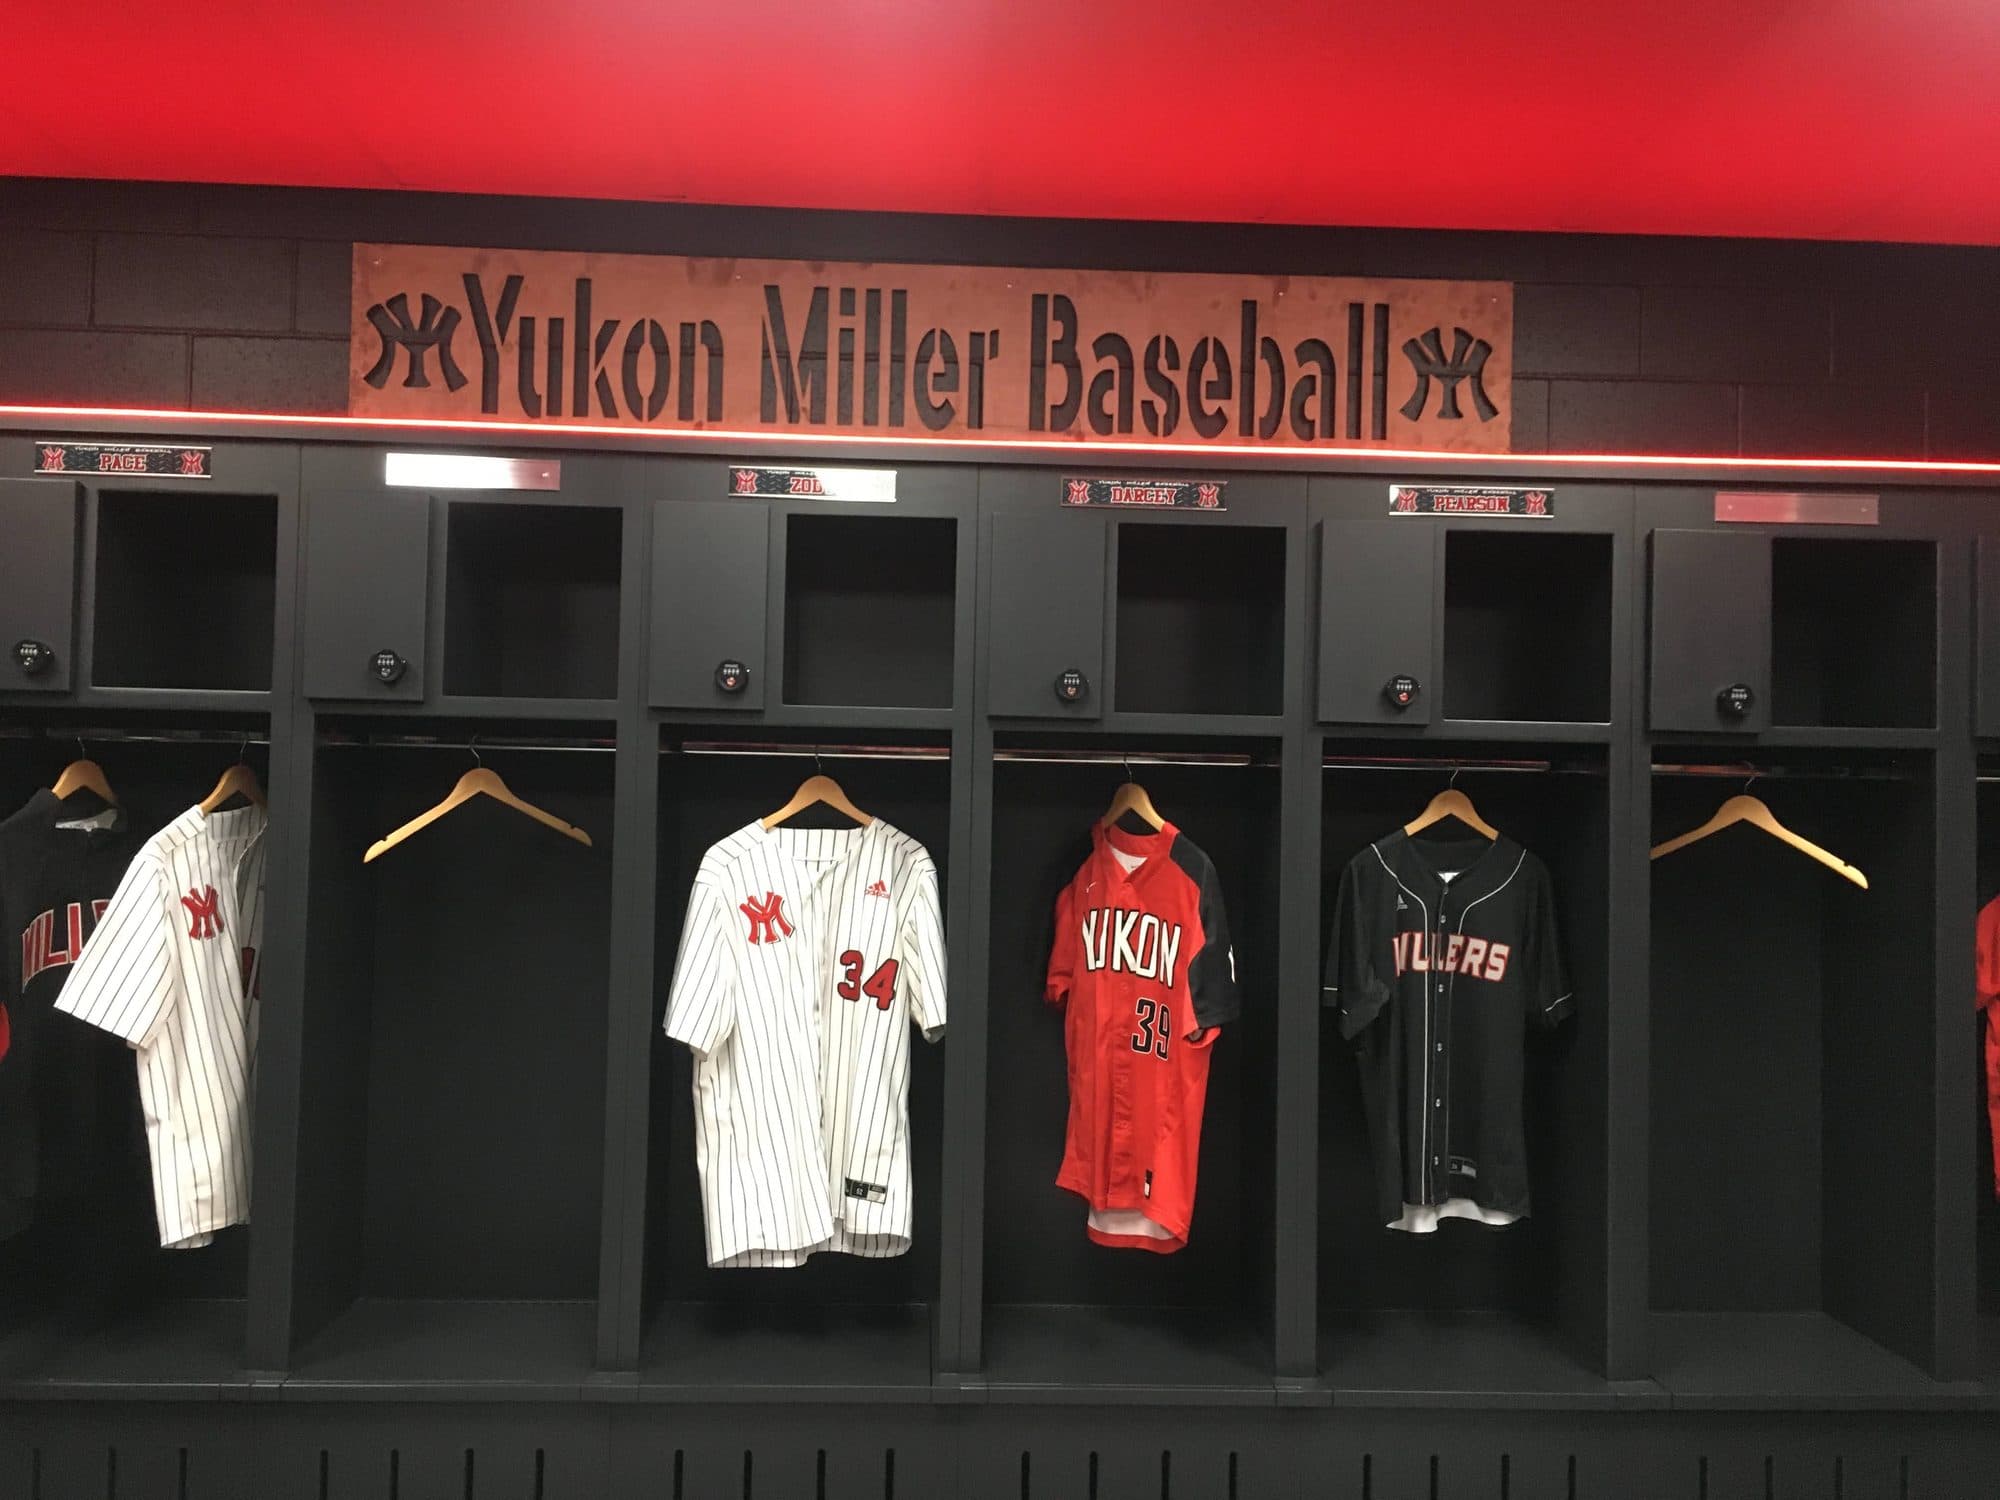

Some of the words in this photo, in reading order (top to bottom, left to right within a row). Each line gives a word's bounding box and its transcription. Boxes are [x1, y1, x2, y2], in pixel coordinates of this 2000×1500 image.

[462, 273, 724, 423] Yukon
[760, 284, 1000, 432] Miller
[1028, 293, 1390, 441] Baseball
[1433, 494, 1511, 513] PEARSON
[837, 949, 900, 1012] 34
[1131, 996, 1173, 1062] 39
